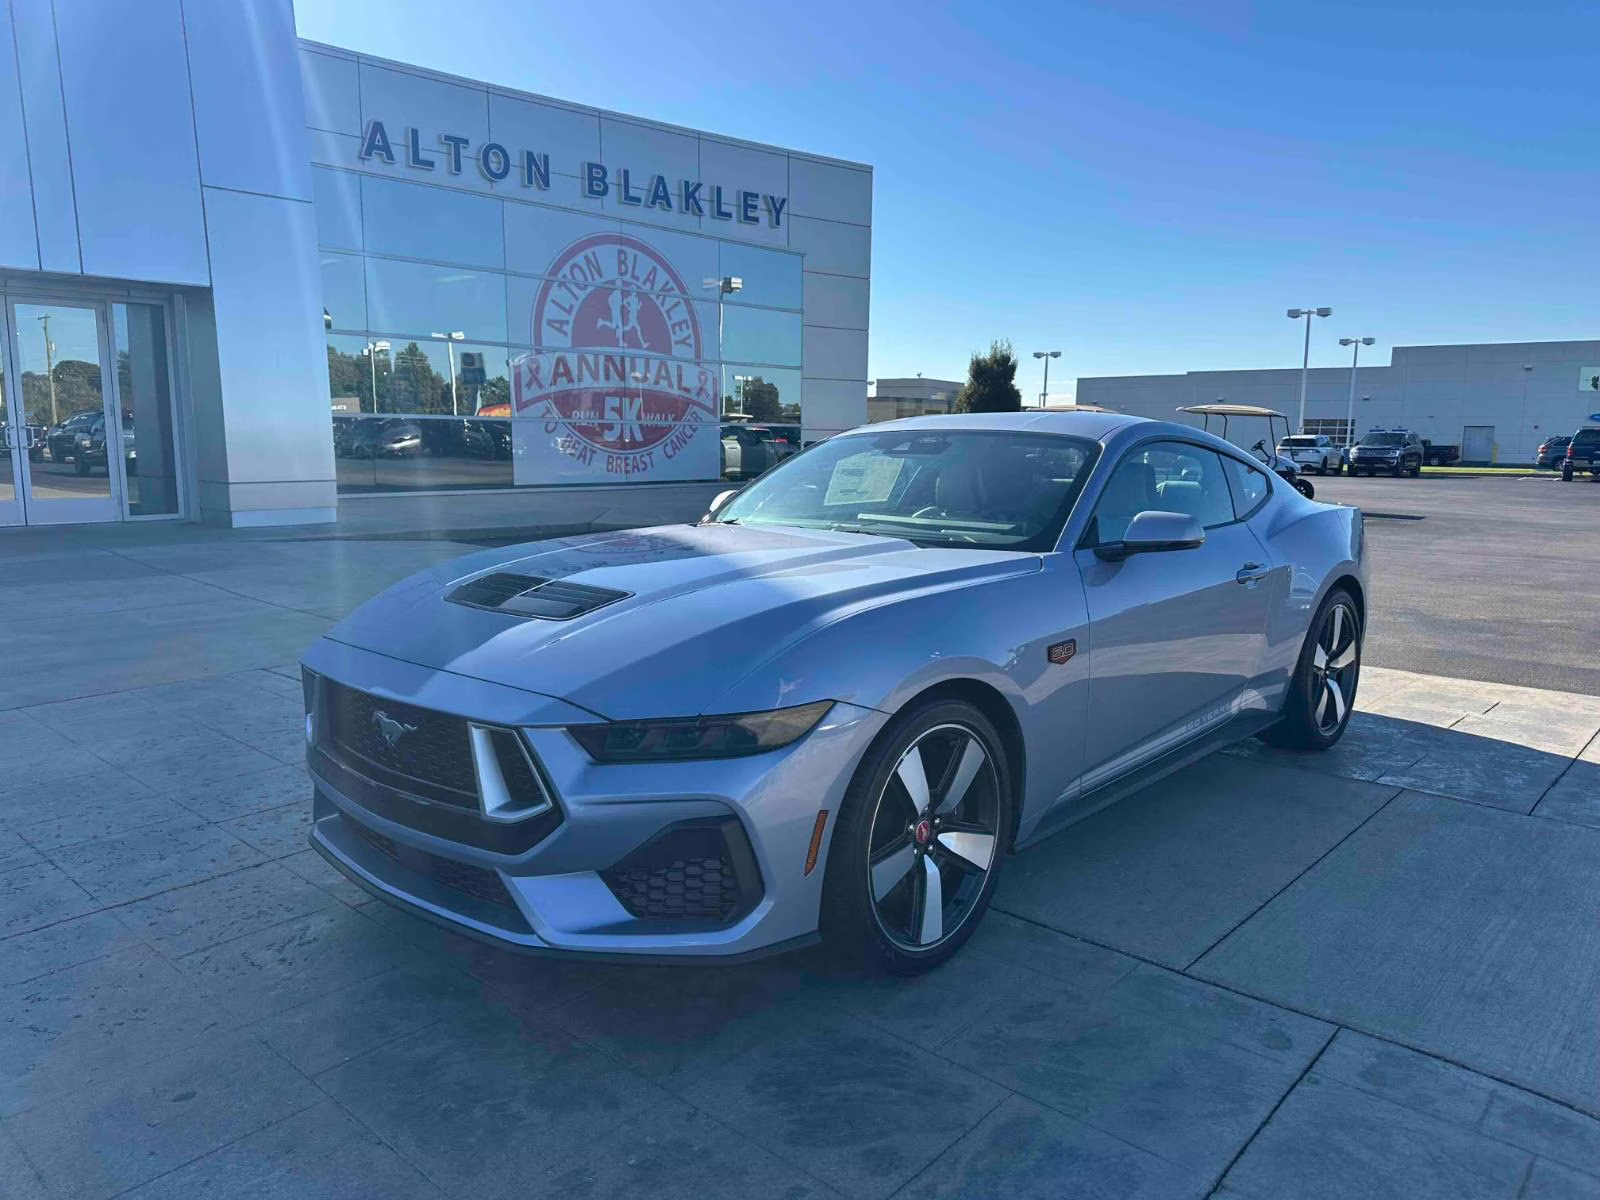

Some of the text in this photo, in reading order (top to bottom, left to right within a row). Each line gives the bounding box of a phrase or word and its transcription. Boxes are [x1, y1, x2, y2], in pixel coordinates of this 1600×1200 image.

[361, 119, 789, 229] ALTON BLAKLEY
[546, 249, 693, 350] ALTON BLAKLEY
[550, 354, 691, 393] ANNUAL
[541, 406, 703, 474] TO BEAT BREAST CANCER
[602, 396, 644, 442] 5K
[641, 413, 676, 428] WALK
